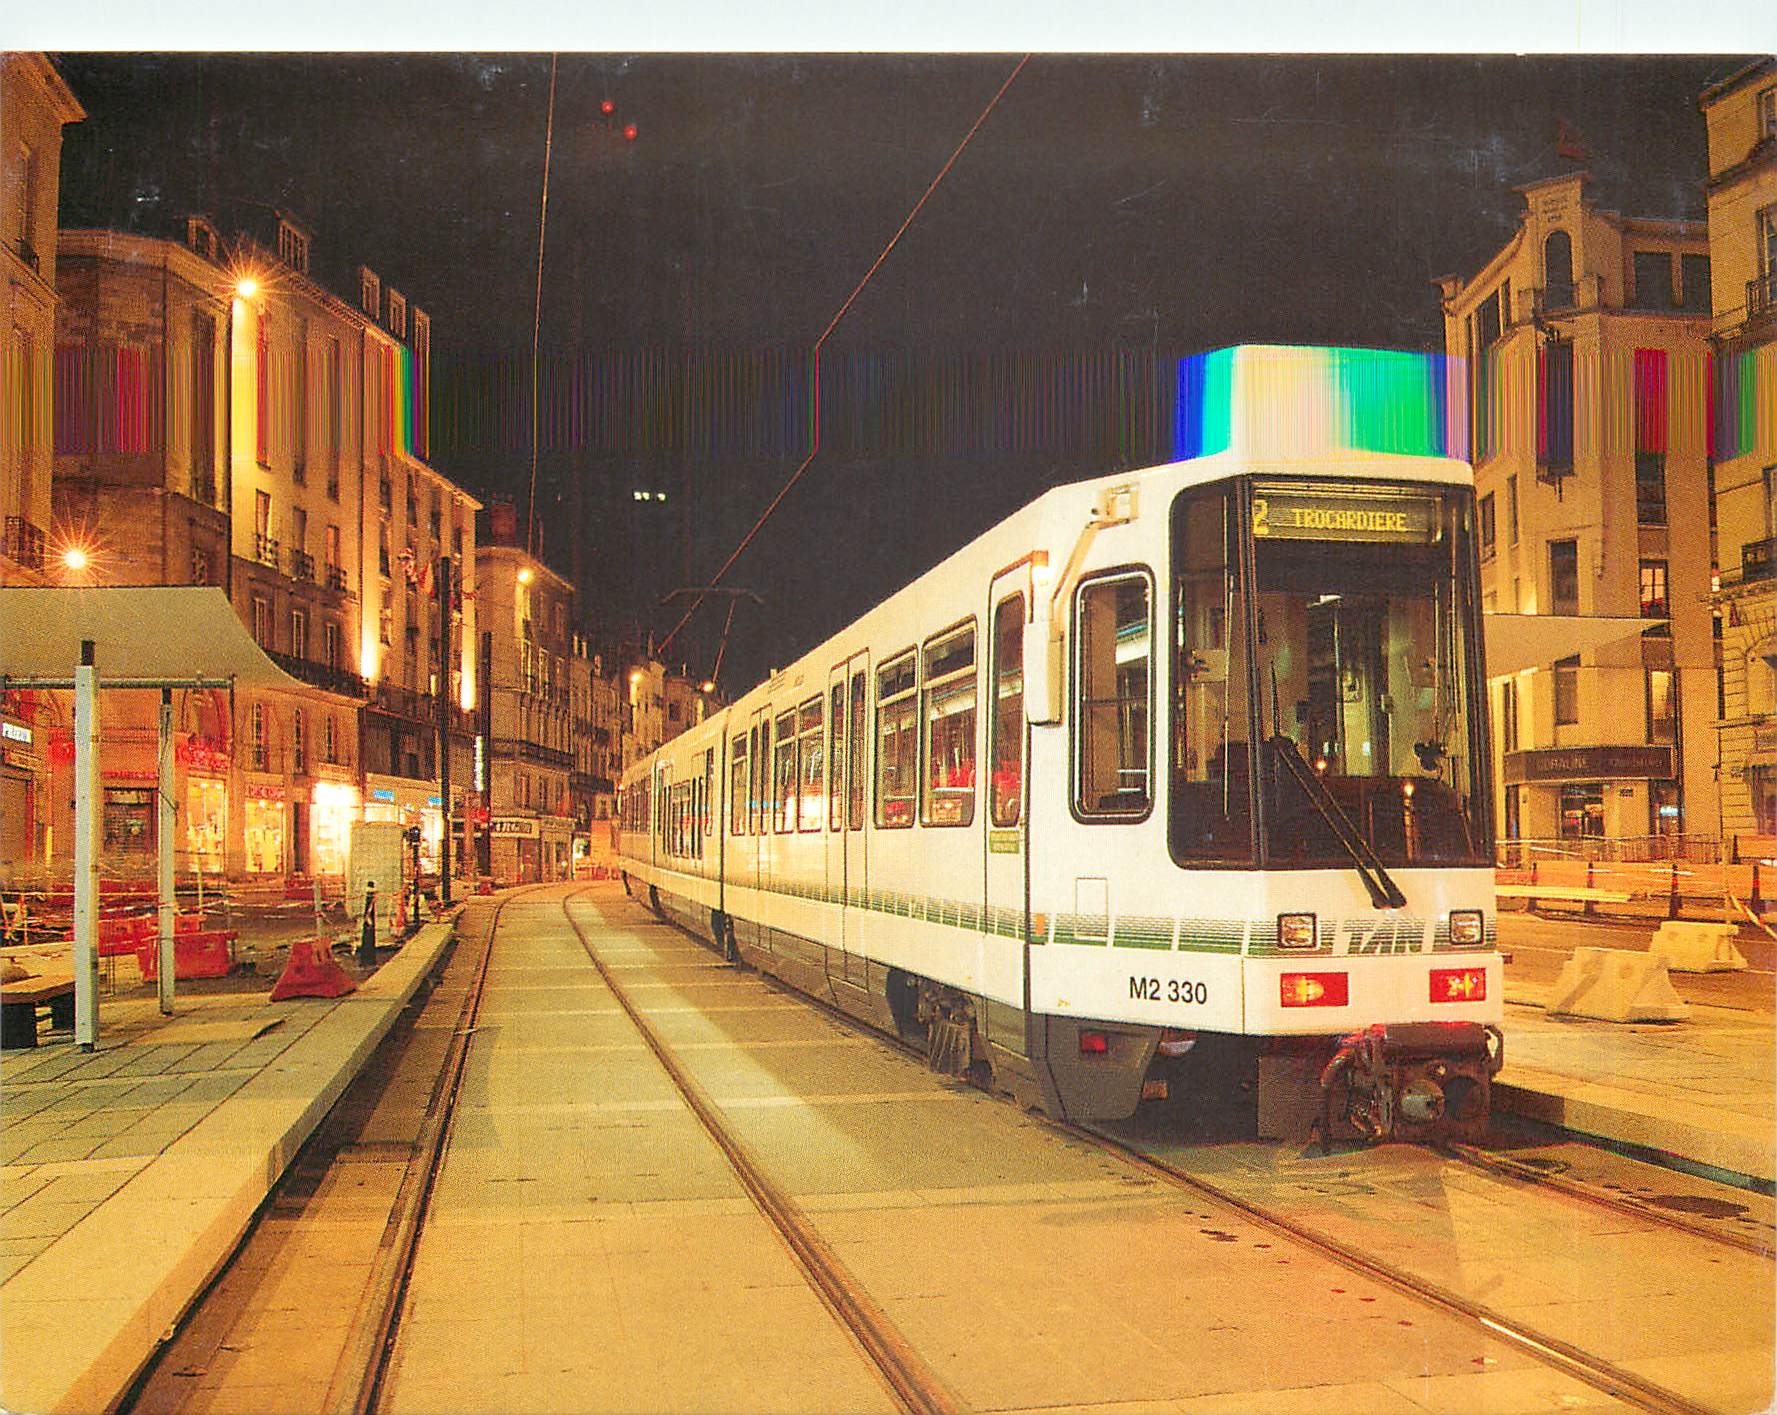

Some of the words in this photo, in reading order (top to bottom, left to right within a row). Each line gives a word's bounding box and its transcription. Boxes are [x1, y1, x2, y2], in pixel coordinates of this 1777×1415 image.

[1252, 499, 1270, 535] 2
[1292, 508, 1408, 531] TROCARDIERE
[1129, 976, 1161, 1000] M2
[1167, 980, 1207, 1004] 330
